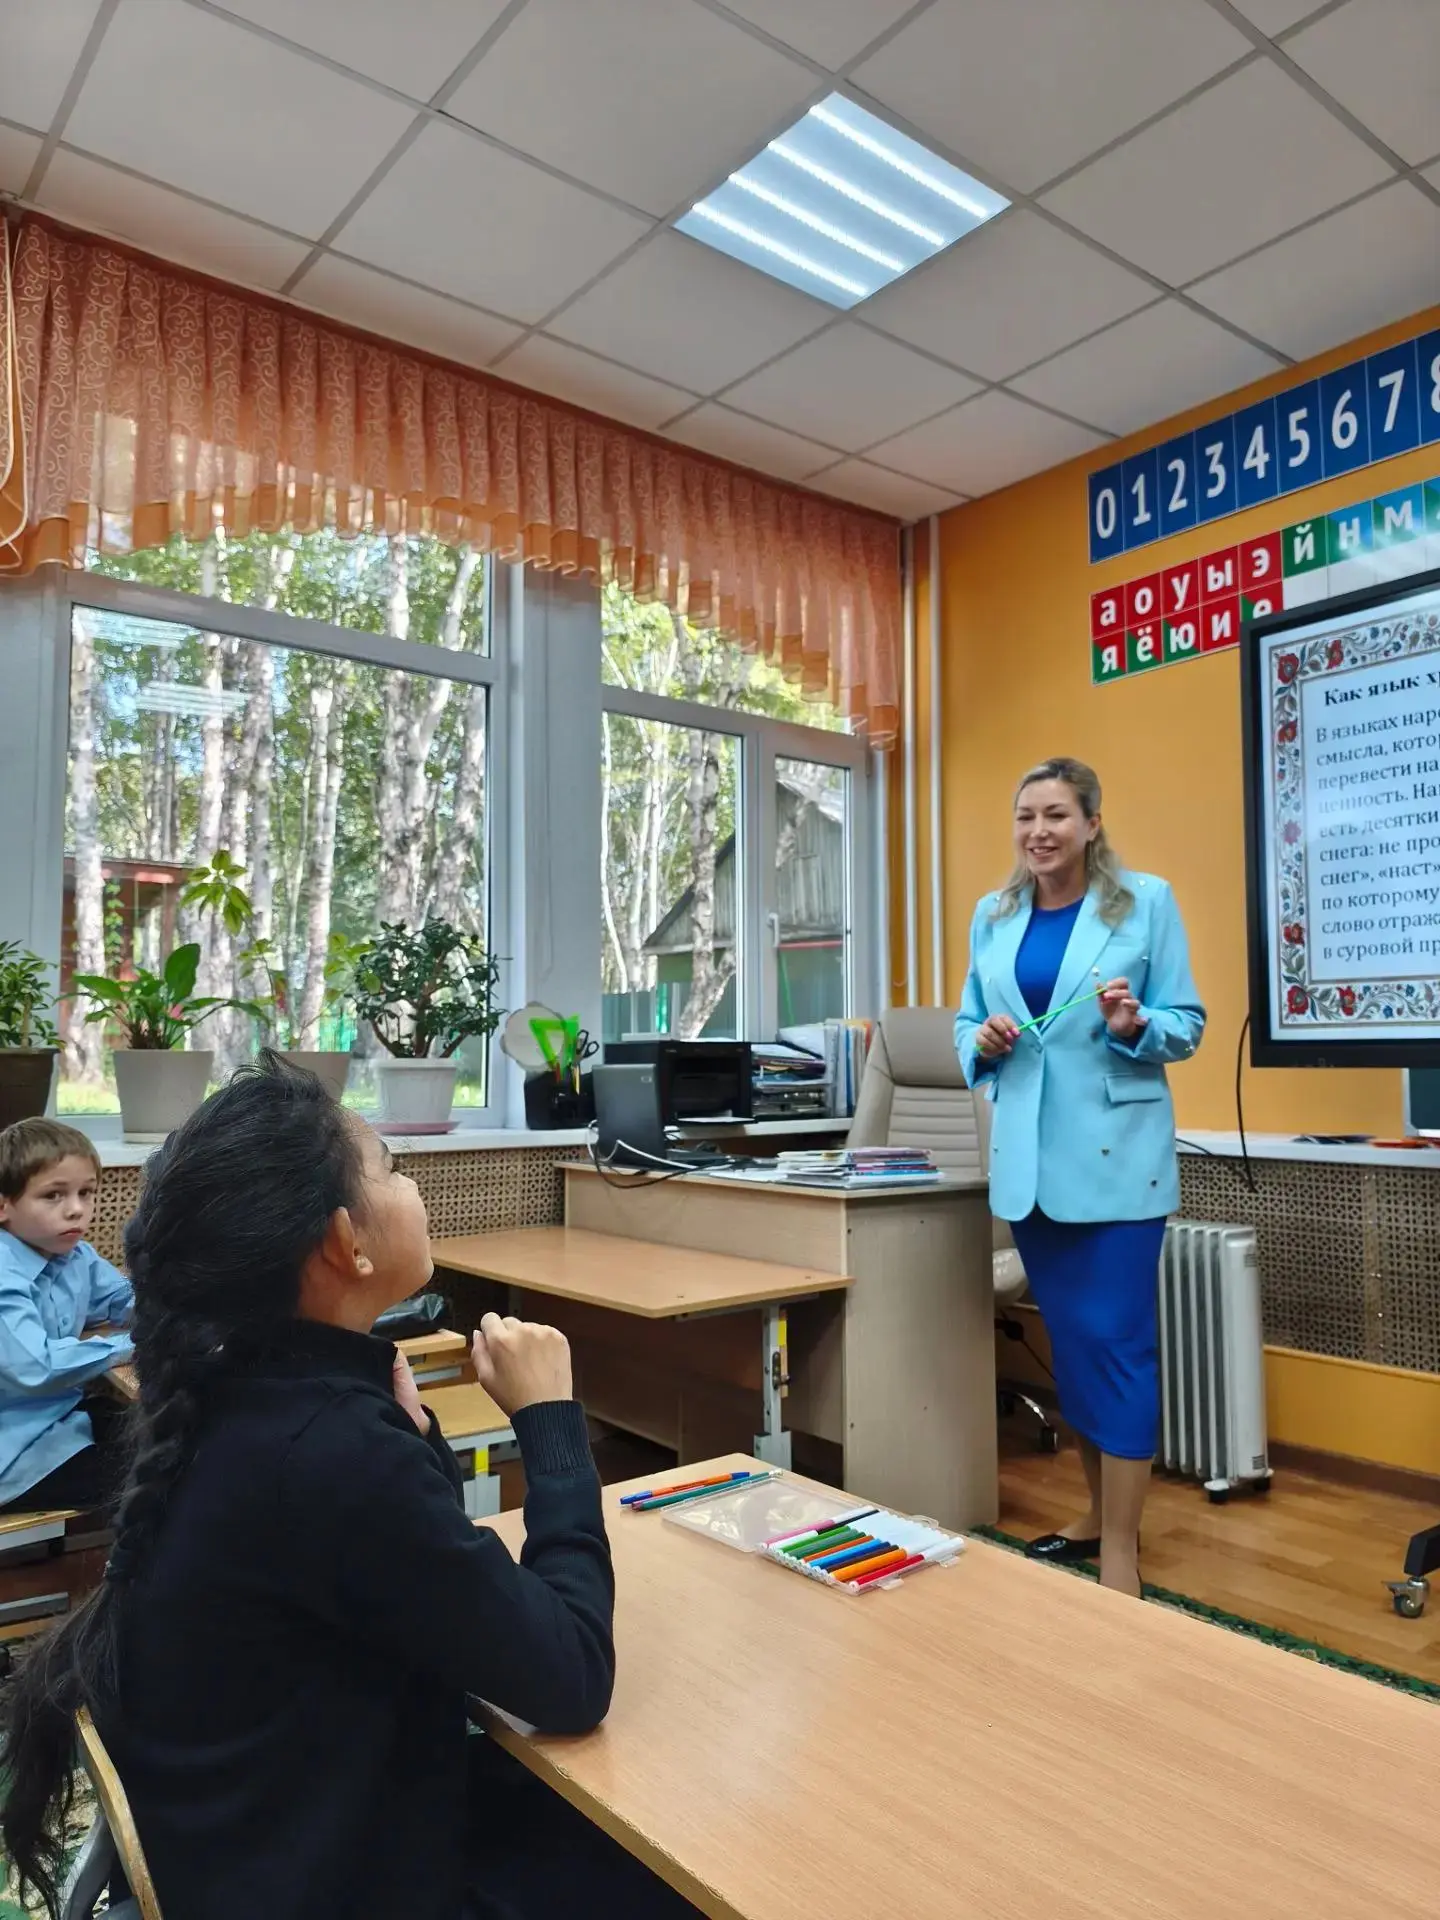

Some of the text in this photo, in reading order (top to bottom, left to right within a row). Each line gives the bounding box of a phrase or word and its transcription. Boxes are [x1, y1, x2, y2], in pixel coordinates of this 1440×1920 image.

[1096, 489, 1116, 539] 0
[1131, 473, 1151, 526] 1
[1167, 458, 1187, 512] 2
[1205, 441, 1226, 498] 3
[1243, 425, 1270, 479] 4
[1288, 407, 1310, 467] 5
[1332, 389, 1357, 449] 6
[1379, 369, 1405, 433] 7
[1100, 499, 1413, 626] а о у ы э й н м
[1102, 645, 1118, 673] я
[1136, 626, 1153, 662] ё
[1170, 622, 1195, 653] ю
[1211, 610, 1231, 641] и
[1324, 671, 1440, 706] Как язык х
[1316, 709, 1440, 743] В языках нар
[1392, 733, 1440, 753] кото
[1318, 759, 1439, 791] перевести на
[1413, 782, 1440, 800] На
[1320, 810, 1439, 838] есть десятки
[1320, 836, 1440, 862] снега: не про
[1320, 869, 1375, 886] снег»,
[1321, 887, 1440, 911] по которому
[1321, 913, 1440, 934] слово отраж
[1323, 947, 1332, 960] в
[1337, 936, 1414, 962] суровой
